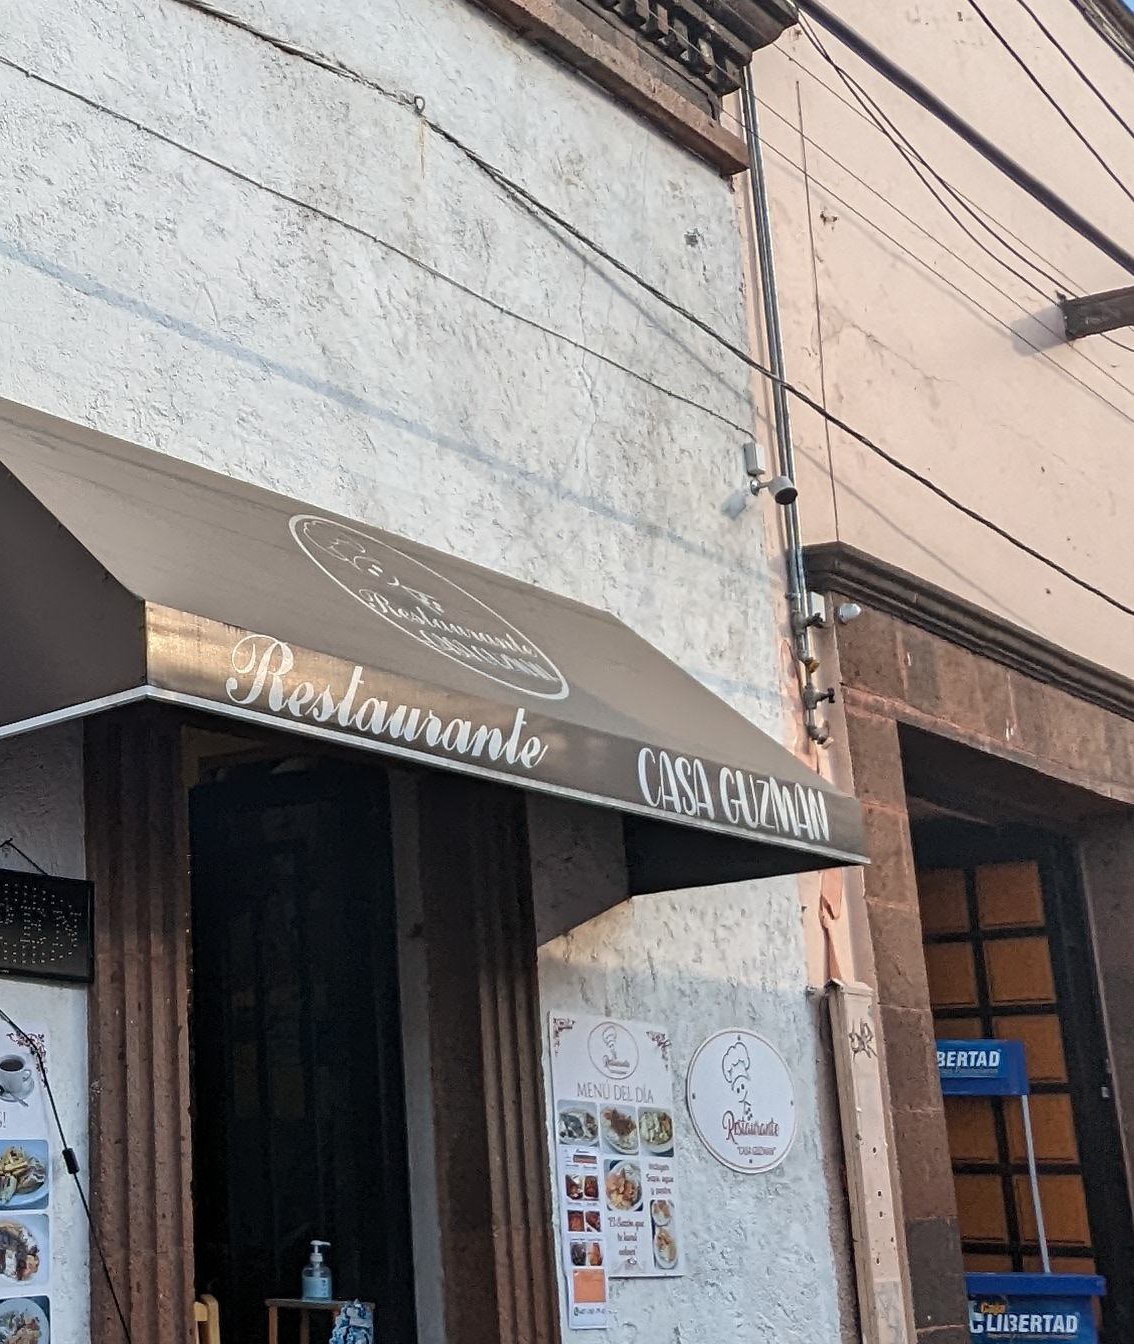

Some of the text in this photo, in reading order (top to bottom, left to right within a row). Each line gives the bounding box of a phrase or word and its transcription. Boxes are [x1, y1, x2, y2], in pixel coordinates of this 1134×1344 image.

[225, 633, 549, 768] Restaurante
[637, 747, 830, 841] CASA GUZMAN
[613, 1084, 633, 1101] DEL
[722, 1110, 780, 1144] Restaurante
[986, 1314, 1079, 1333] LIBERTAD
